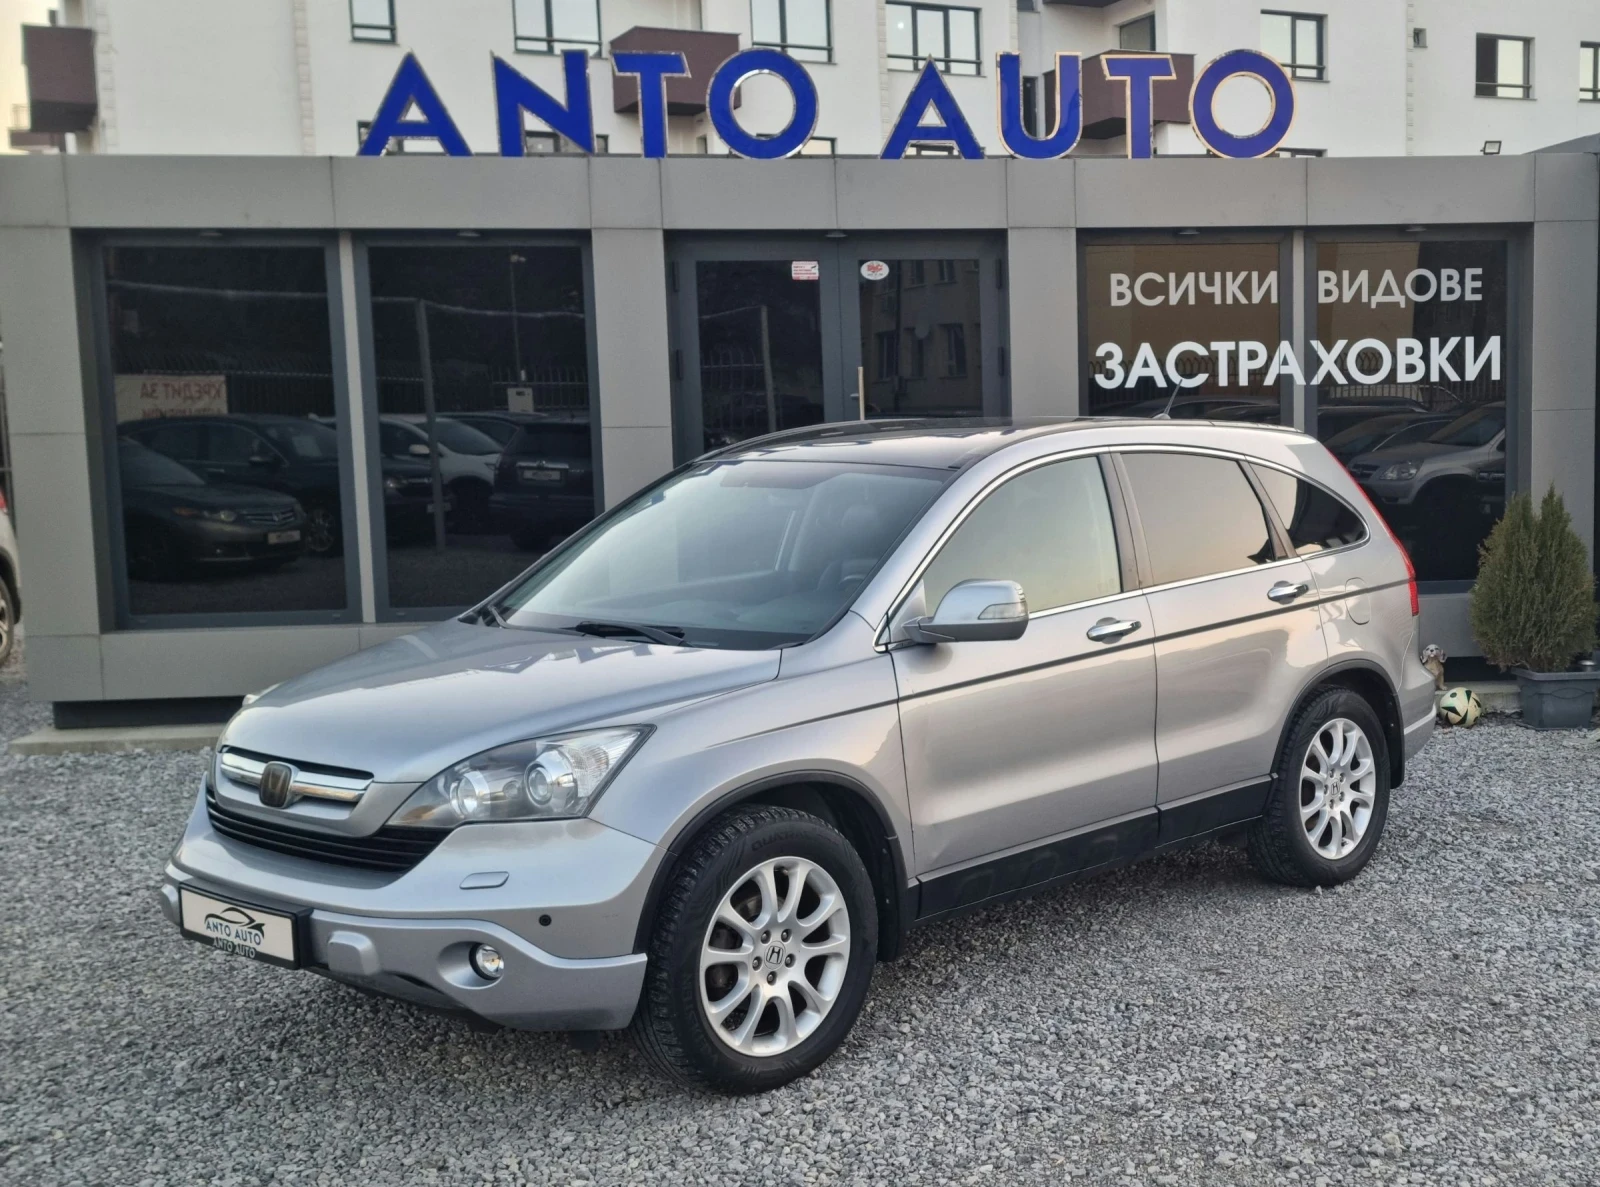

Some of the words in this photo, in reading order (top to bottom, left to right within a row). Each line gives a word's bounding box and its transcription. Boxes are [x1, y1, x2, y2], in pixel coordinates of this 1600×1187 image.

[357, 47, 819, 159] ANTO
[879, 48, 1298, 159] AUTO
[1109, 270, 1279, 307] ВСИЧКИ
[1317, 267, 1484, 309] ВИДОВЕ
[1093, 335, 1502, 390] ЗАСТРАХОВКИ
[205, 920, 232, 938] ANTO
[234, 928, 262, 946] AUTO
[213, 937, 233, 952] ANTO
[235, 944, 256, 959] AUTO
